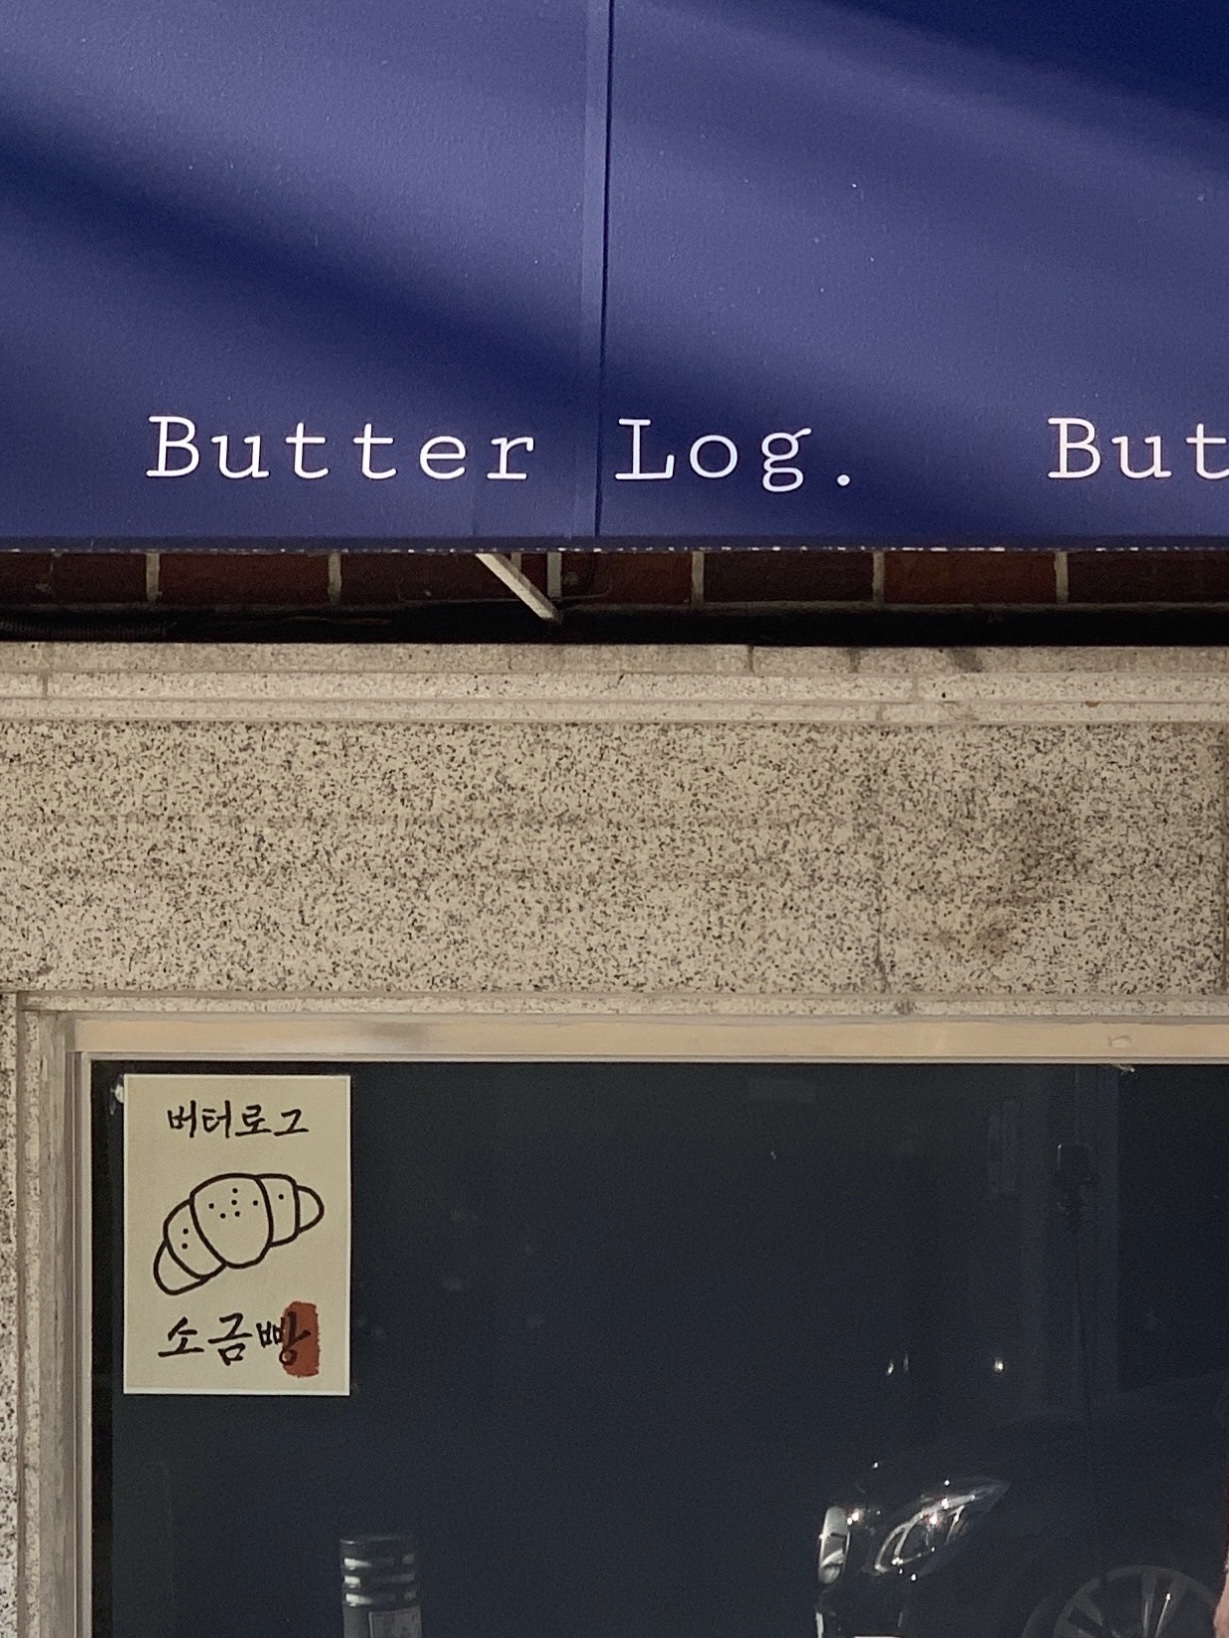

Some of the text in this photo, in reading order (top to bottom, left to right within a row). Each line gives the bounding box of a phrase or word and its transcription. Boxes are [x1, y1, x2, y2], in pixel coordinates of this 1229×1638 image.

[146, 415, 851, 493] Butter Log.
[167, 1099, 309, 1139] 버터로그
[158, 1311, 311, 1366] 소금빵
